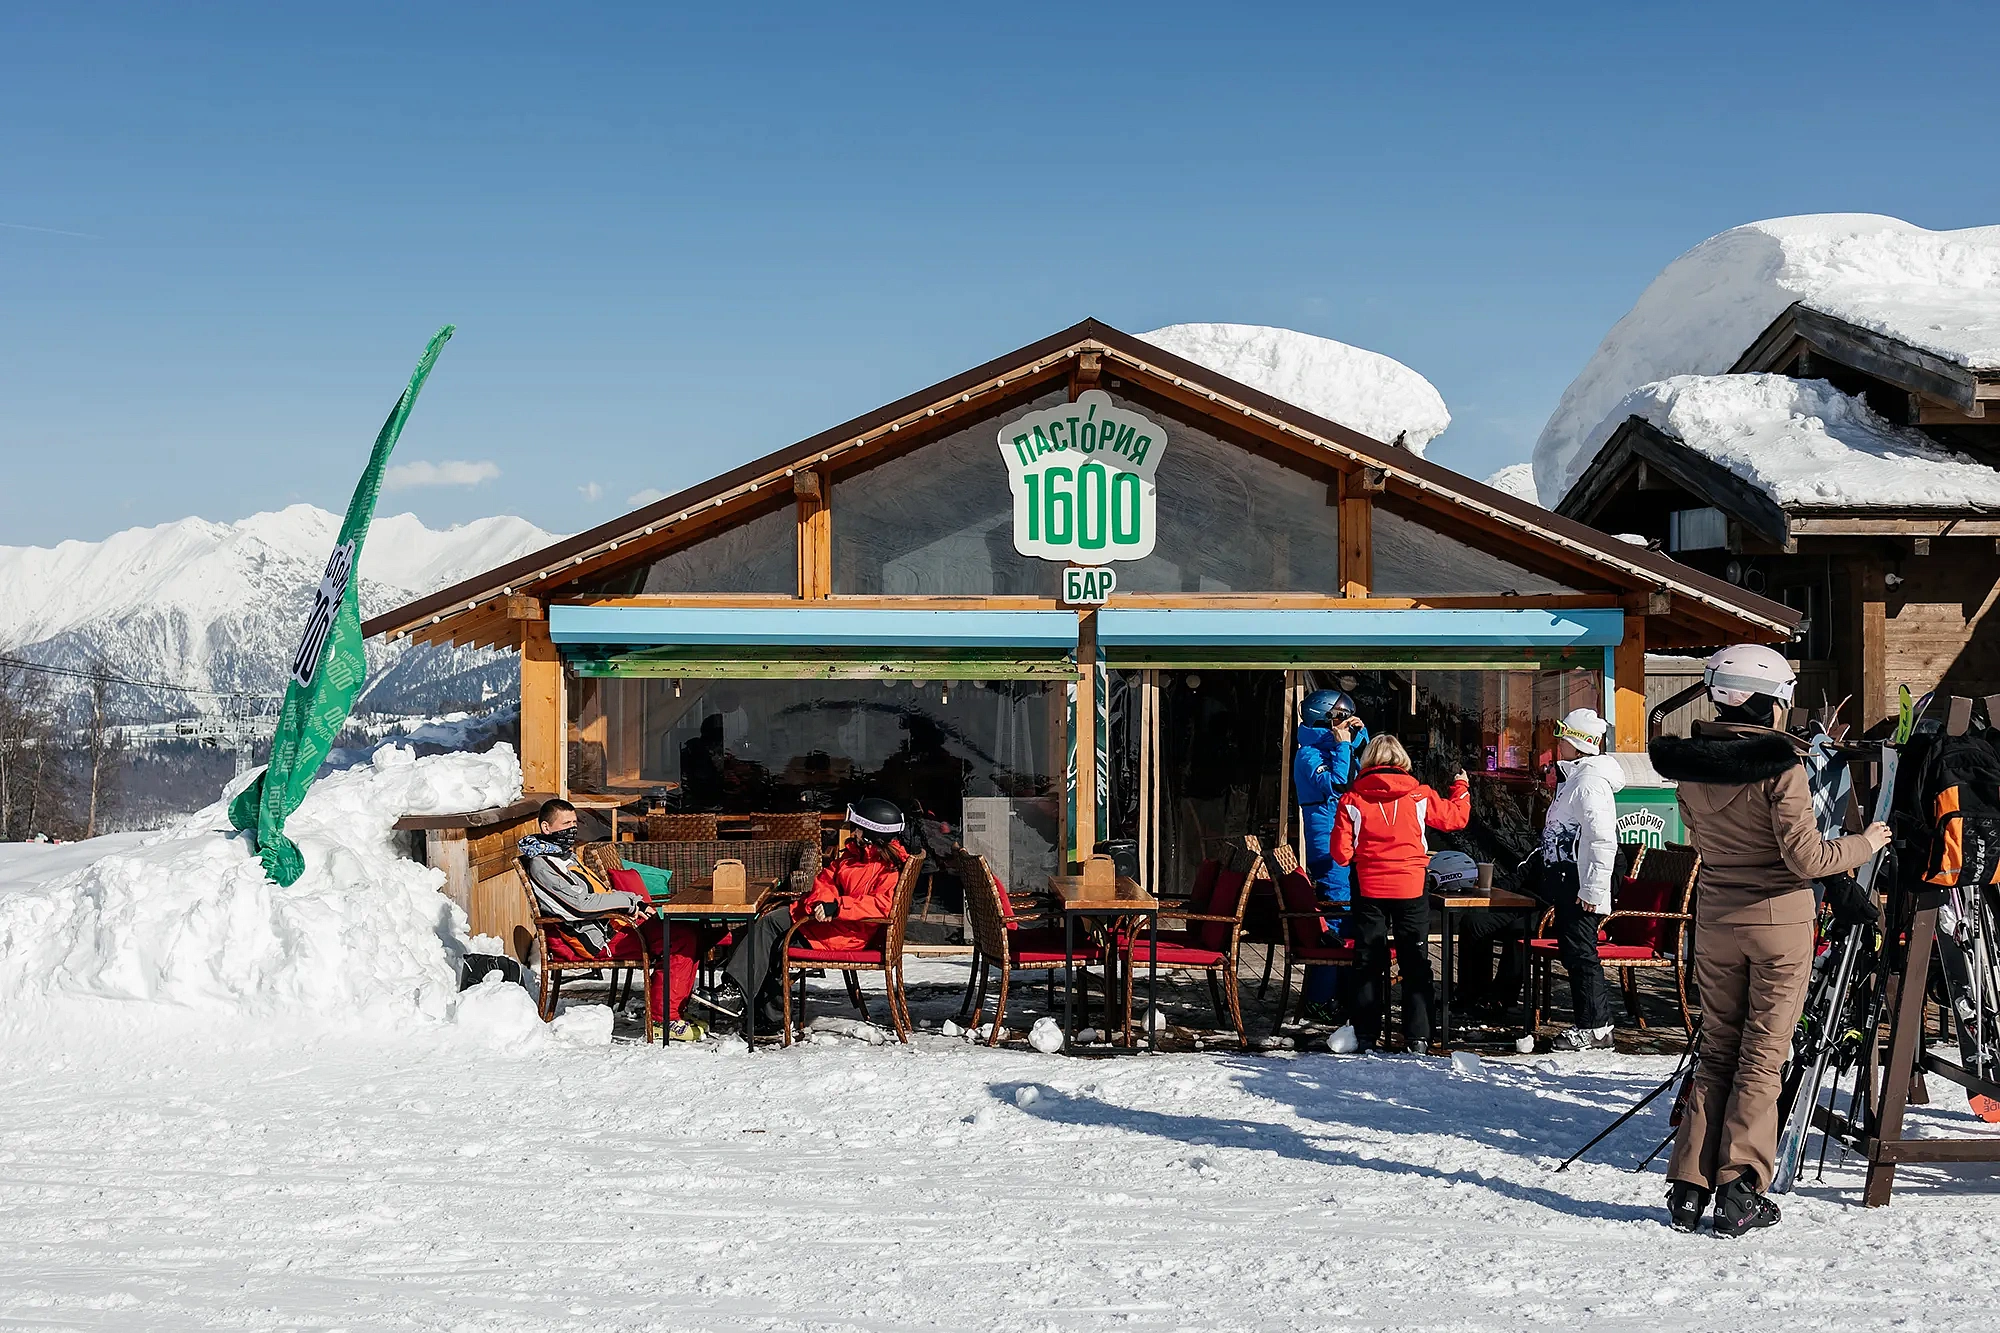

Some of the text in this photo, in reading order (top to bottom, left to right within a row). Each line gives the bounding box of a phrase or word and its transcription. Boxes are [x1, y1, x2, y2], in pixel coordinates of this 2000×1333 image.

[1023, 464, 1141, 550] 1600
[1067, 571, 1113, 600] БАР
[325, 657, 355, 692] 1600
[1566, 728, 1586, 739] SMITH
[860, 820, 890, 832] DRAGON
